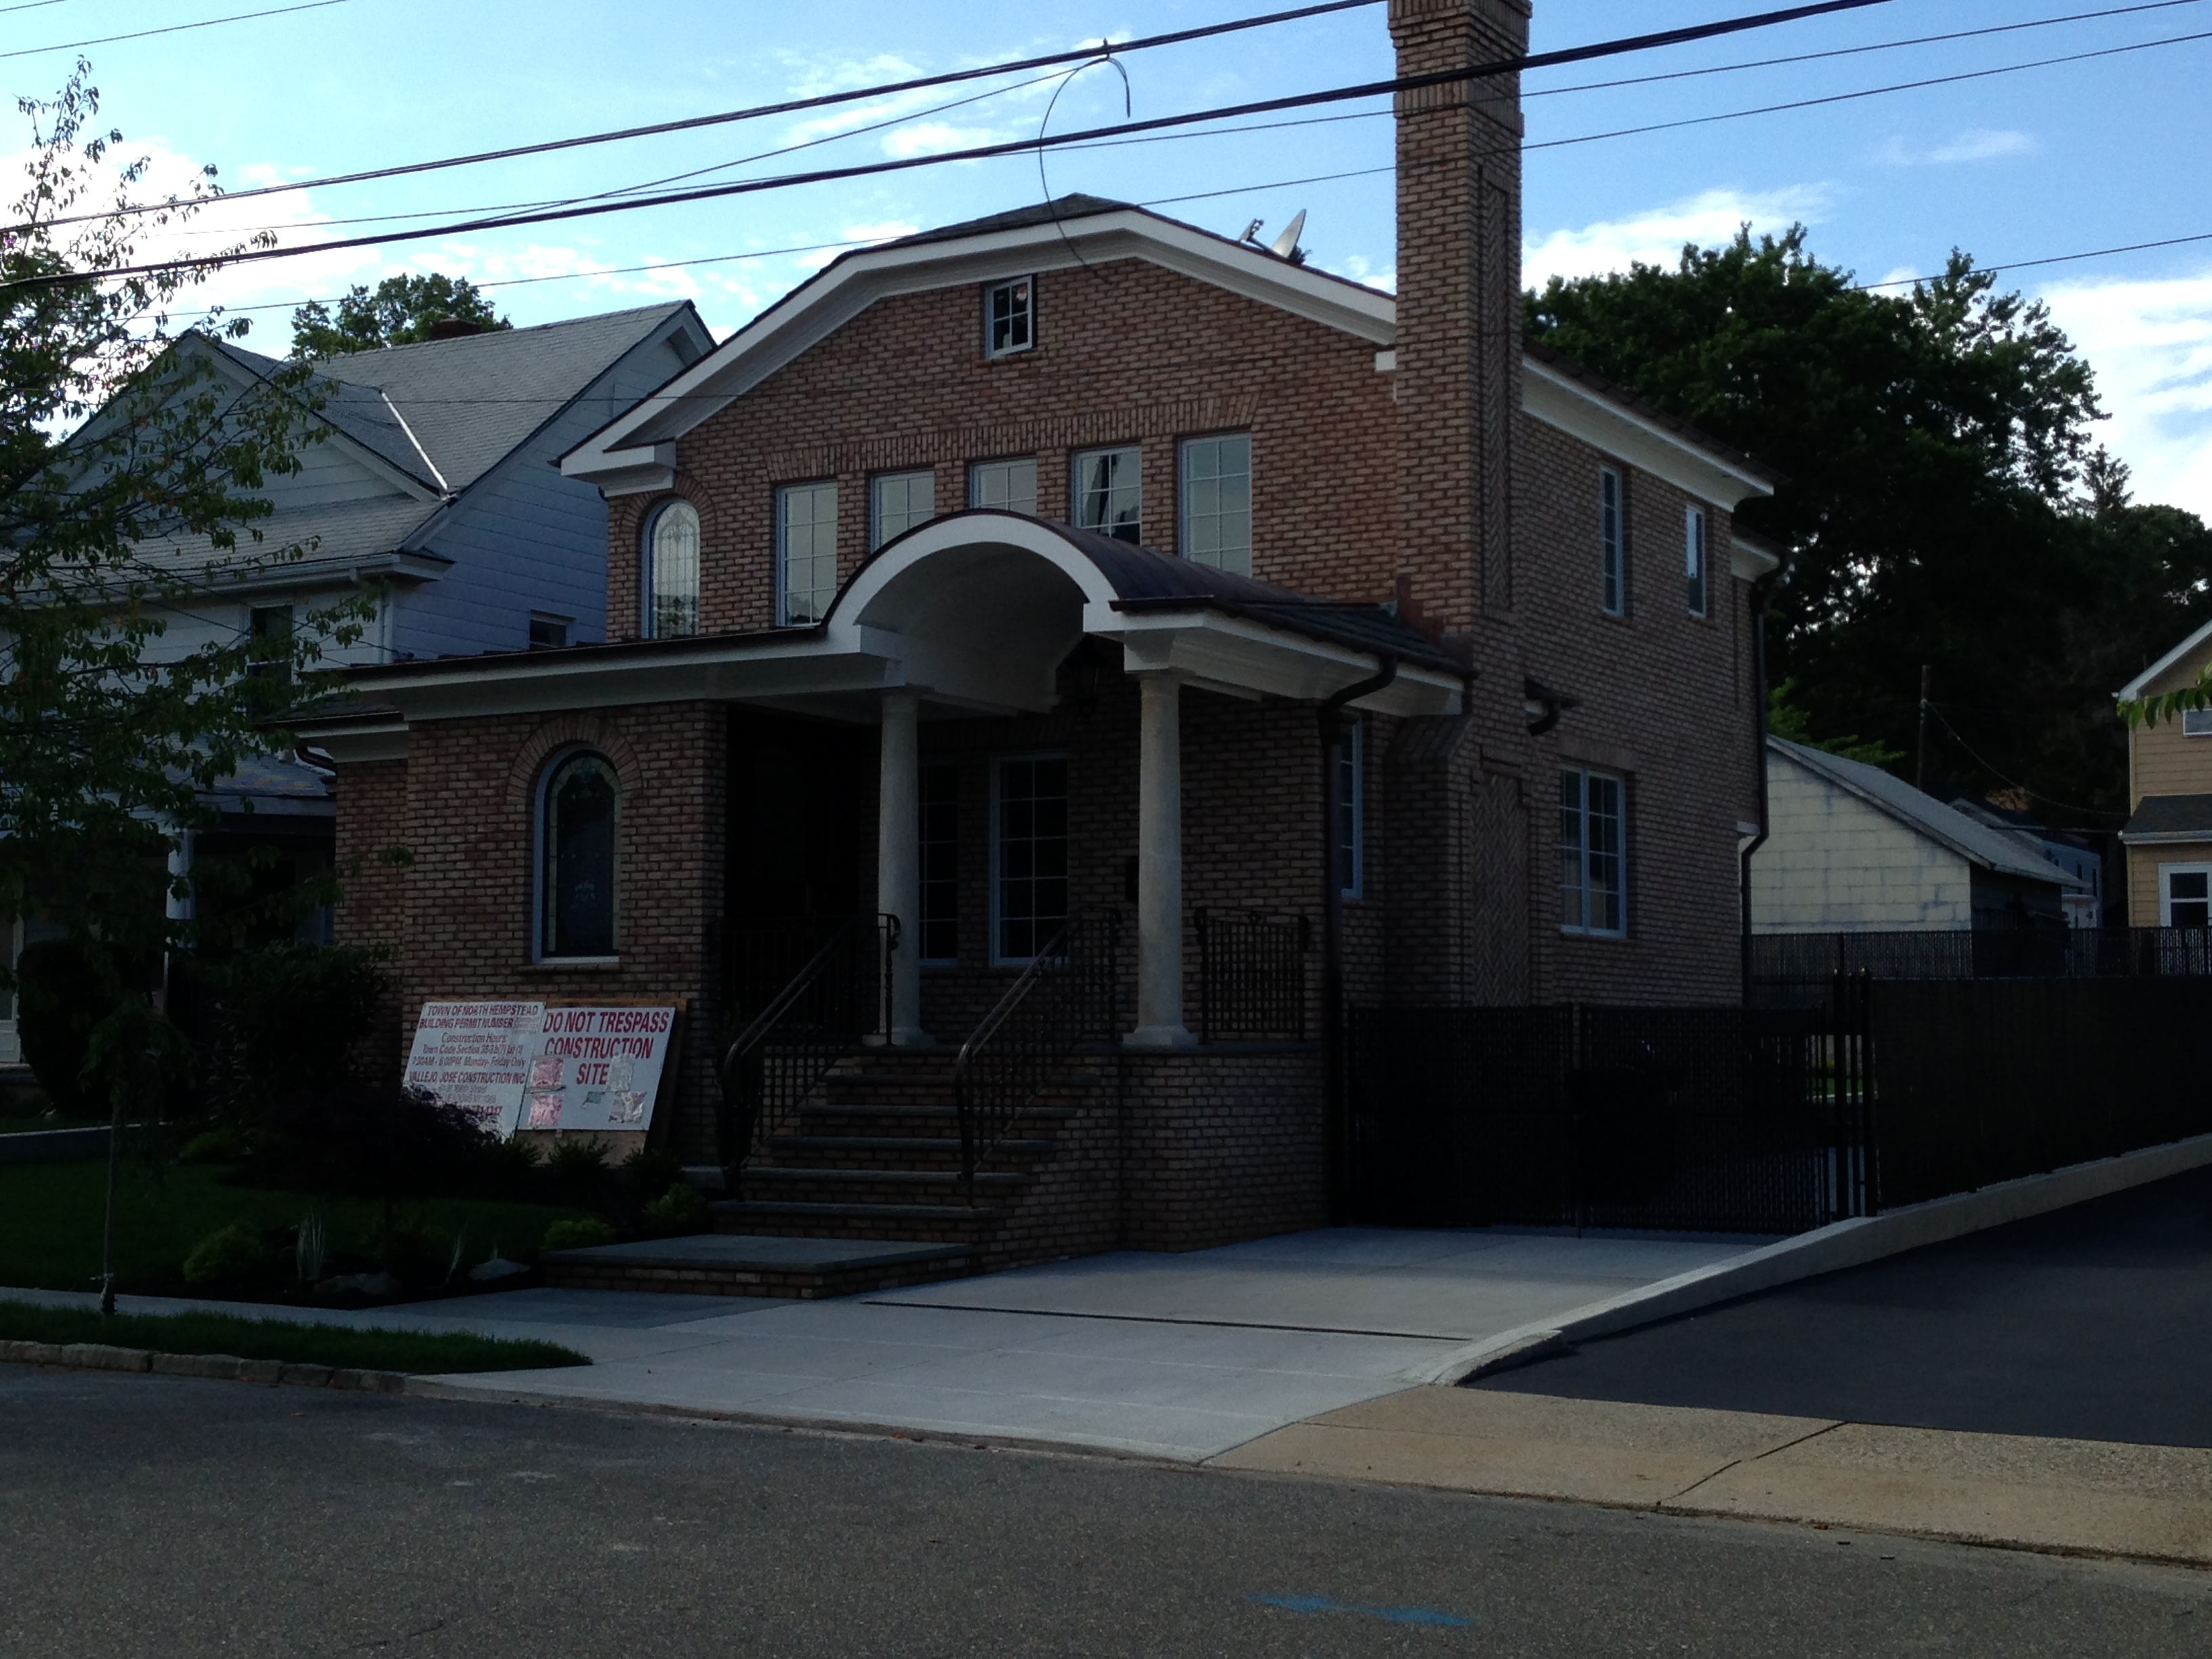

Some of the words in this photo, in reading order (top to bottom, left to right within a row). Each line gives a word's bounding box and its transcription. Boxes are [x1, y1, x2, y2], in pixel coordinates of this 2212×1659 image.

[428, 1005, 450, 1016] TOWN
[451, 1005, 463, 1016] OF
[463, 1005, 488, 1016] NORTH
[489, 1004, 538, 1016] HEMPSTEAD
[419, 1018, 455, 1029] BUILDING
[454, 1018, 482, 1029] PERMIT
[482, 1018, 514, 1028] NUMBER
[543, 1012, 563, 1033] DO
[564, 1011, 596, 1033] NOT
[599, 1011, 670, 1033] TRESPASS
[441, 1031, 485, 1043] Construction
[545, 1037, 654, 1059] CONSTRUCTION
[439, 1071, 458, 1084] JOSE
[458, 1071, 512, 1084] CONSTRUCTION
[512, 1072, 526, 1084] INC
[577, 1063, 611, 1085] SITE
